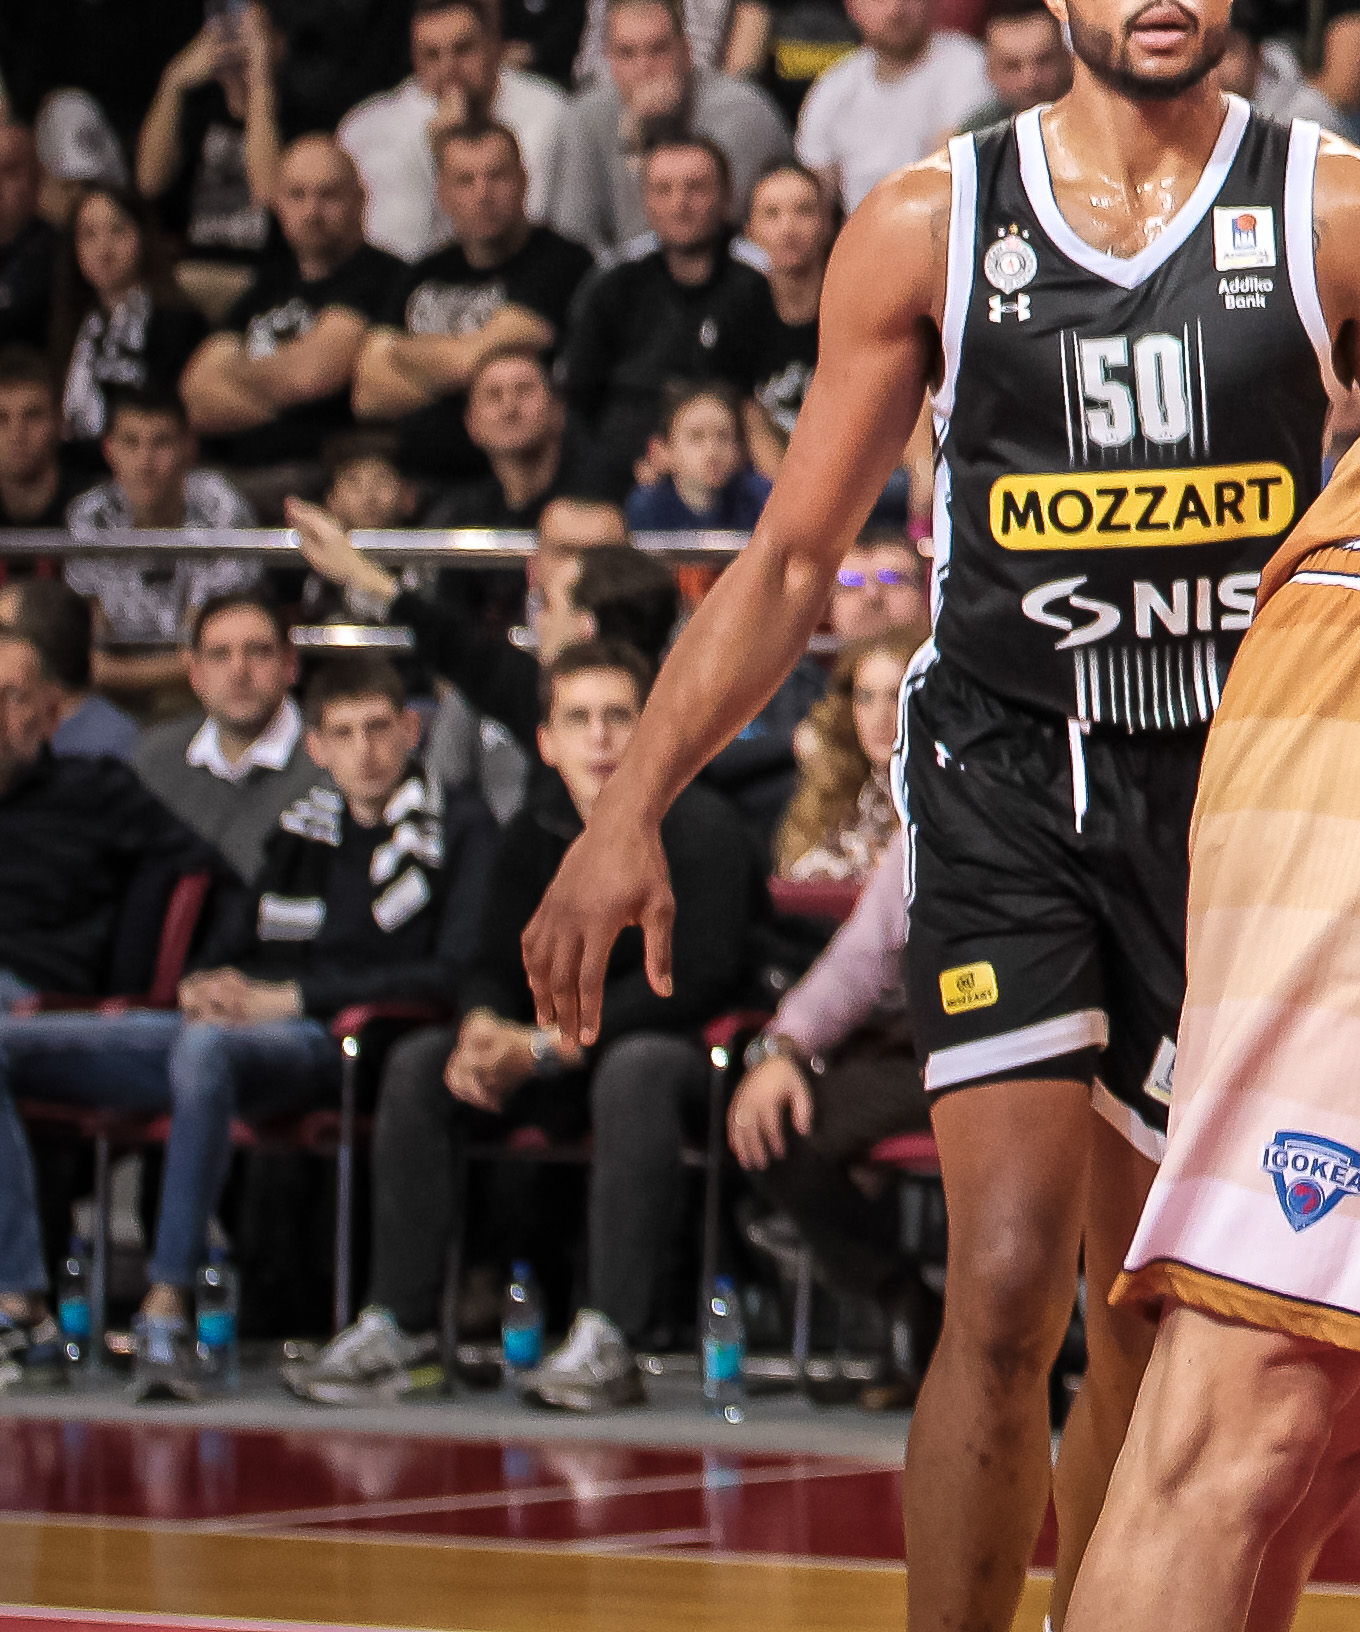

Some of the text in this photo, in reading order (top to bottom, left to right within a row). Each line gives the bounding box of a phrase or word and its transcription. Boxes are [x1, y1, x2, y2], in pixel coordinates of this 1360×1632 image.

[1218, 275, 1273, 294] Addiko
[1225, 293, 1266, 309] Bank
[1078, 333, 1191, 448] 50
[1001, 473, 1283, 536] MOZZART
